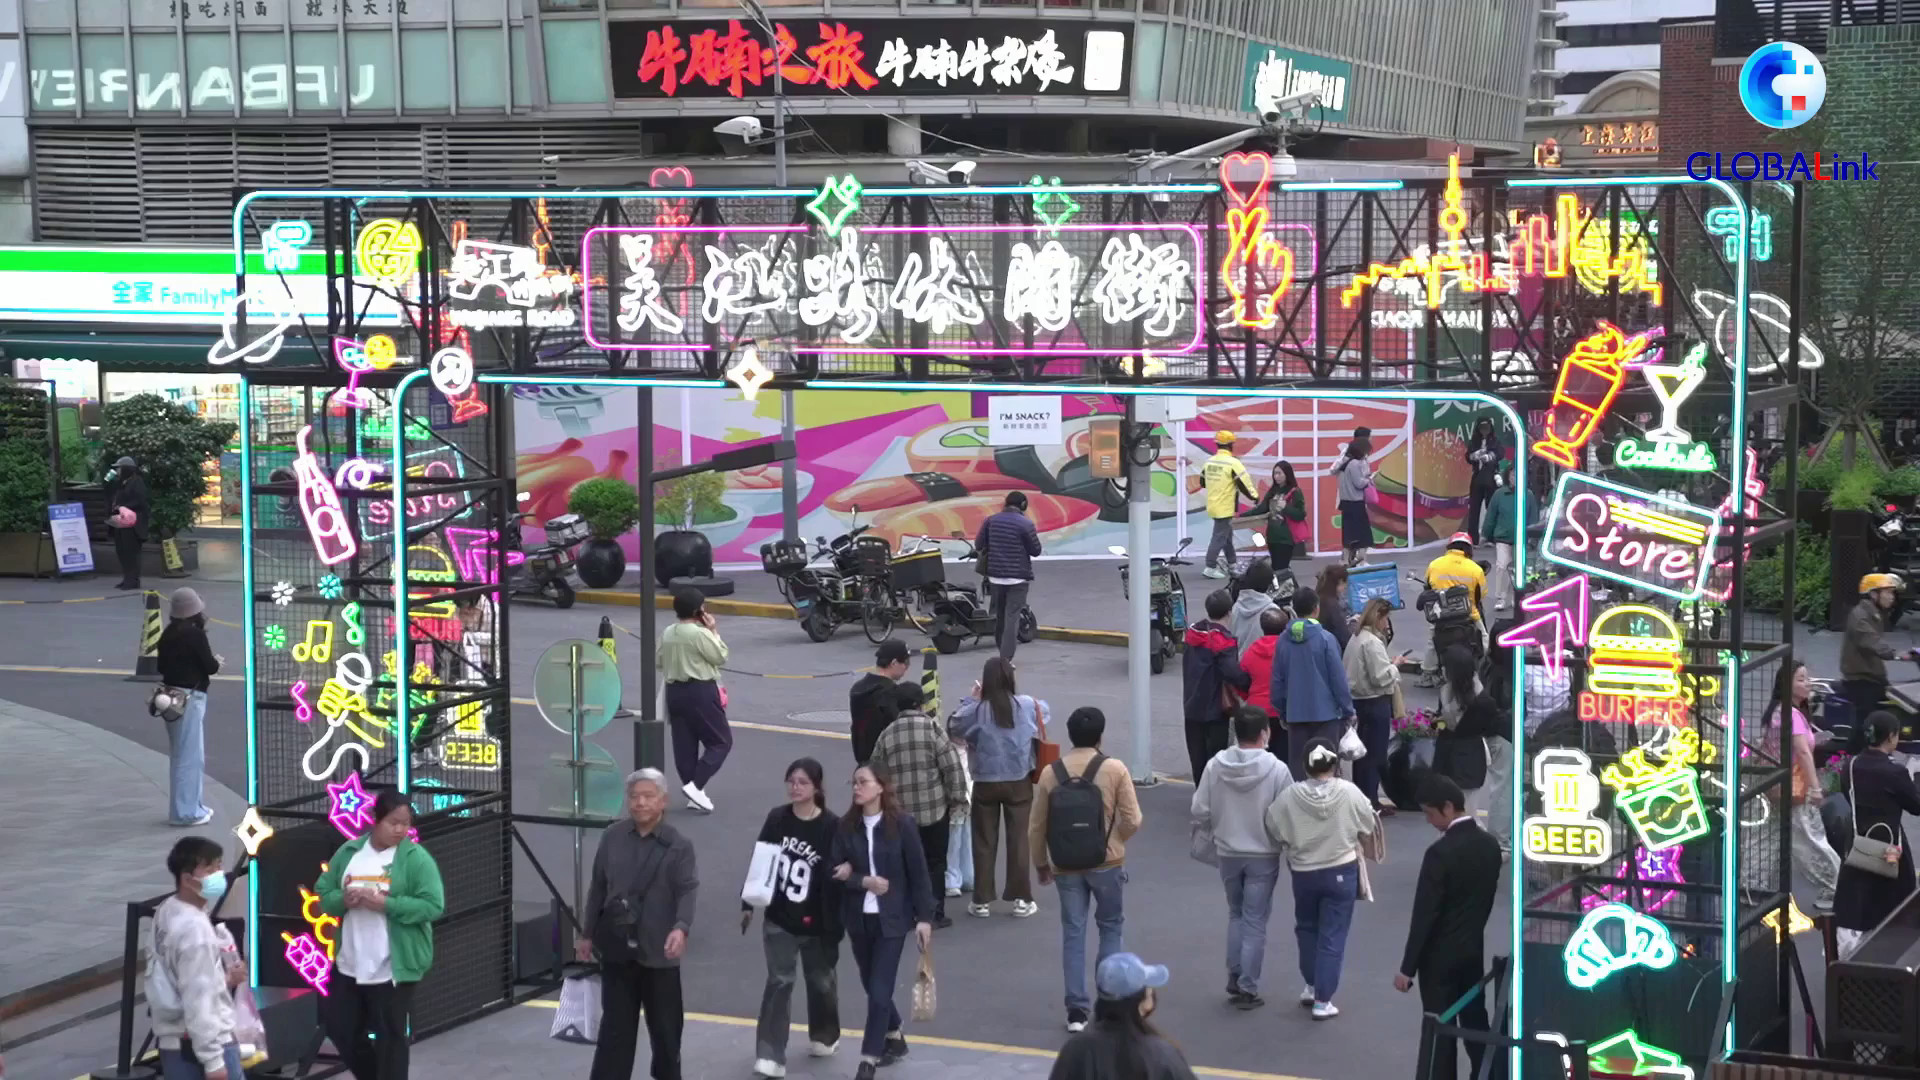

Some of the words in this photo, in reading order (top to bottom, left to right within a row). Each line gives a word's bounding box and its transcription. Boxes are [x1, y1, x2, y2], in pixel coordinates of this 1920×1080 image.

[637, 18, 879, 98] 牛腩之旅
[112, 280, 154, 304] 全家
[160, 286, 265, 310] FamilyM
[999, 412, 1013, 421] I'M
[1015, 412, 1051, 421] SNACK?
[1562, 492, 1696, 580] Store
[1579, 692, 1688, 725] BURGER
[1529, 825, 1603, 855] BEER
